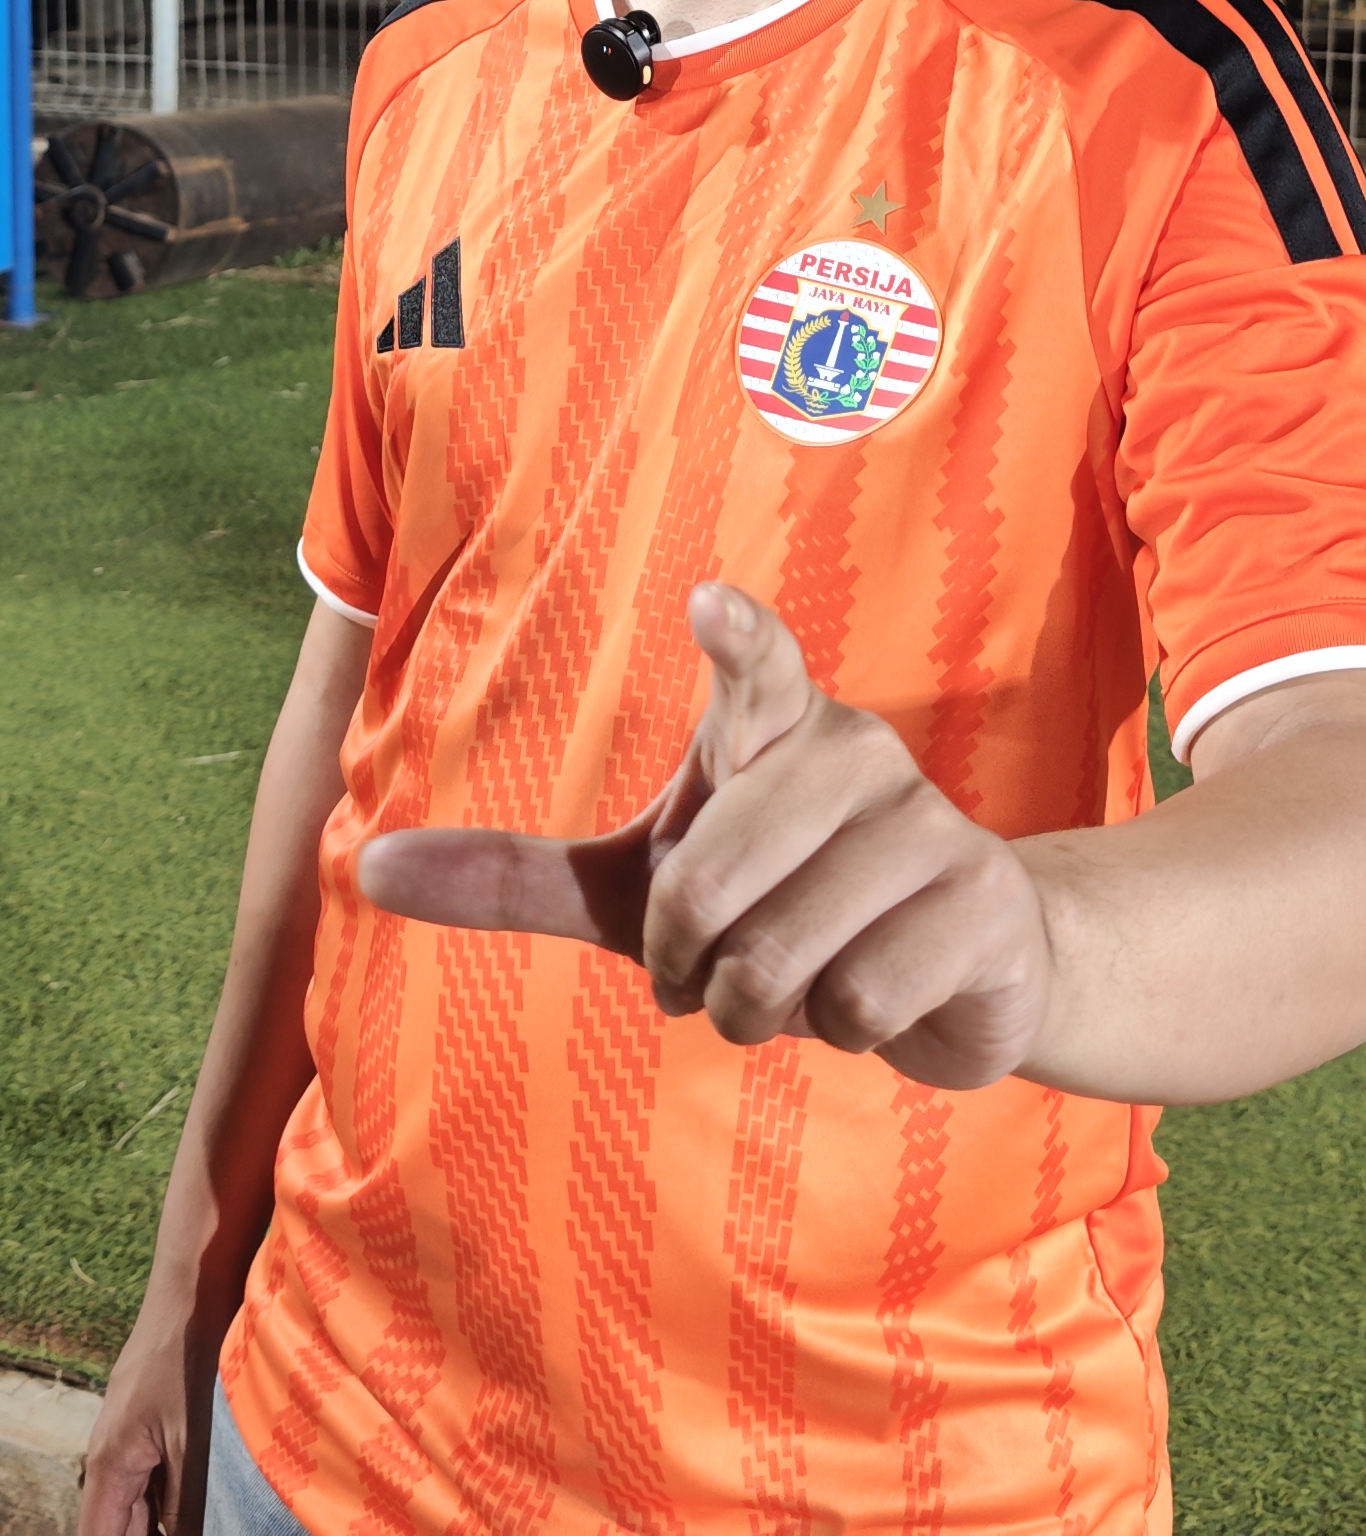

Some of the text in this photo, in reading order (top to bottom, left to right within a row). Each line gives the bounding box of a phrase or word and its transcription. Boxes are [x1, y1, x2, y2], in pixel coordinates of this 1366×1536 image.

[800, 254, 912, 298] PERSIJA
[809, 287, 891, 316] JAYA RAYA
